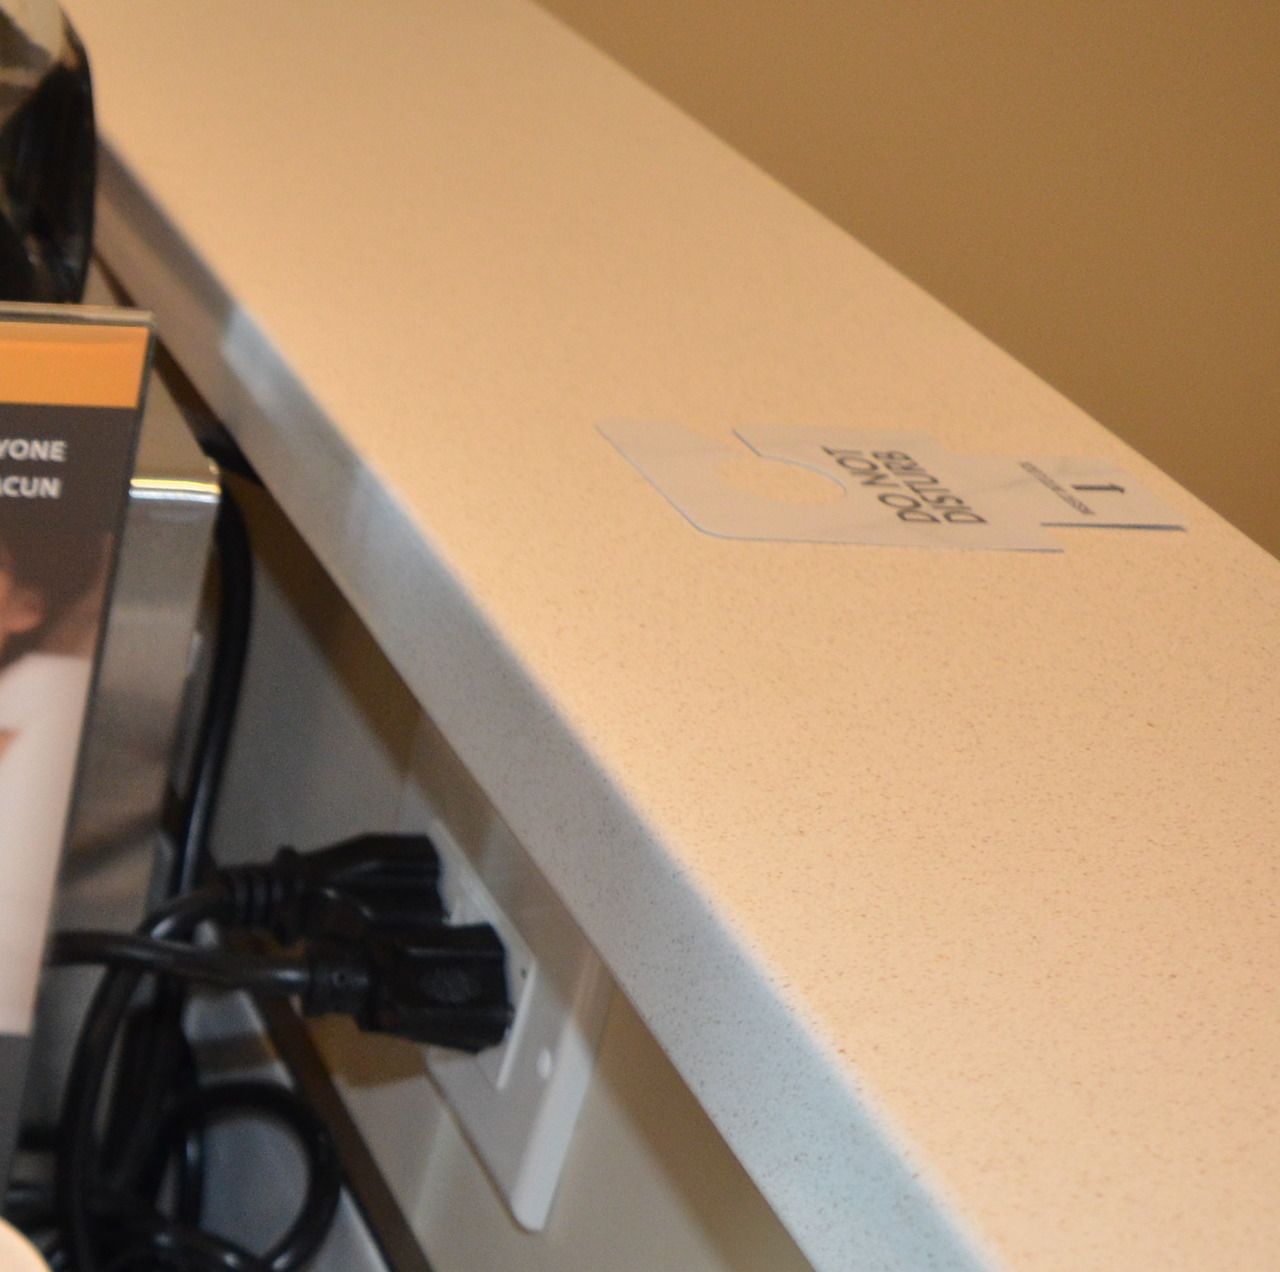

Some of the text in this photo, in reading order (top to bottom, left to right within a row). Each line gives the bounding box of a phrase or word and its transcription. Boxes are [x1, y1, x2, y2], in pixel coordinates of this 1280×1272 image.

[821, 445, 941, 524] DO NOT
[872, 449, 988, 524] DISTURB
